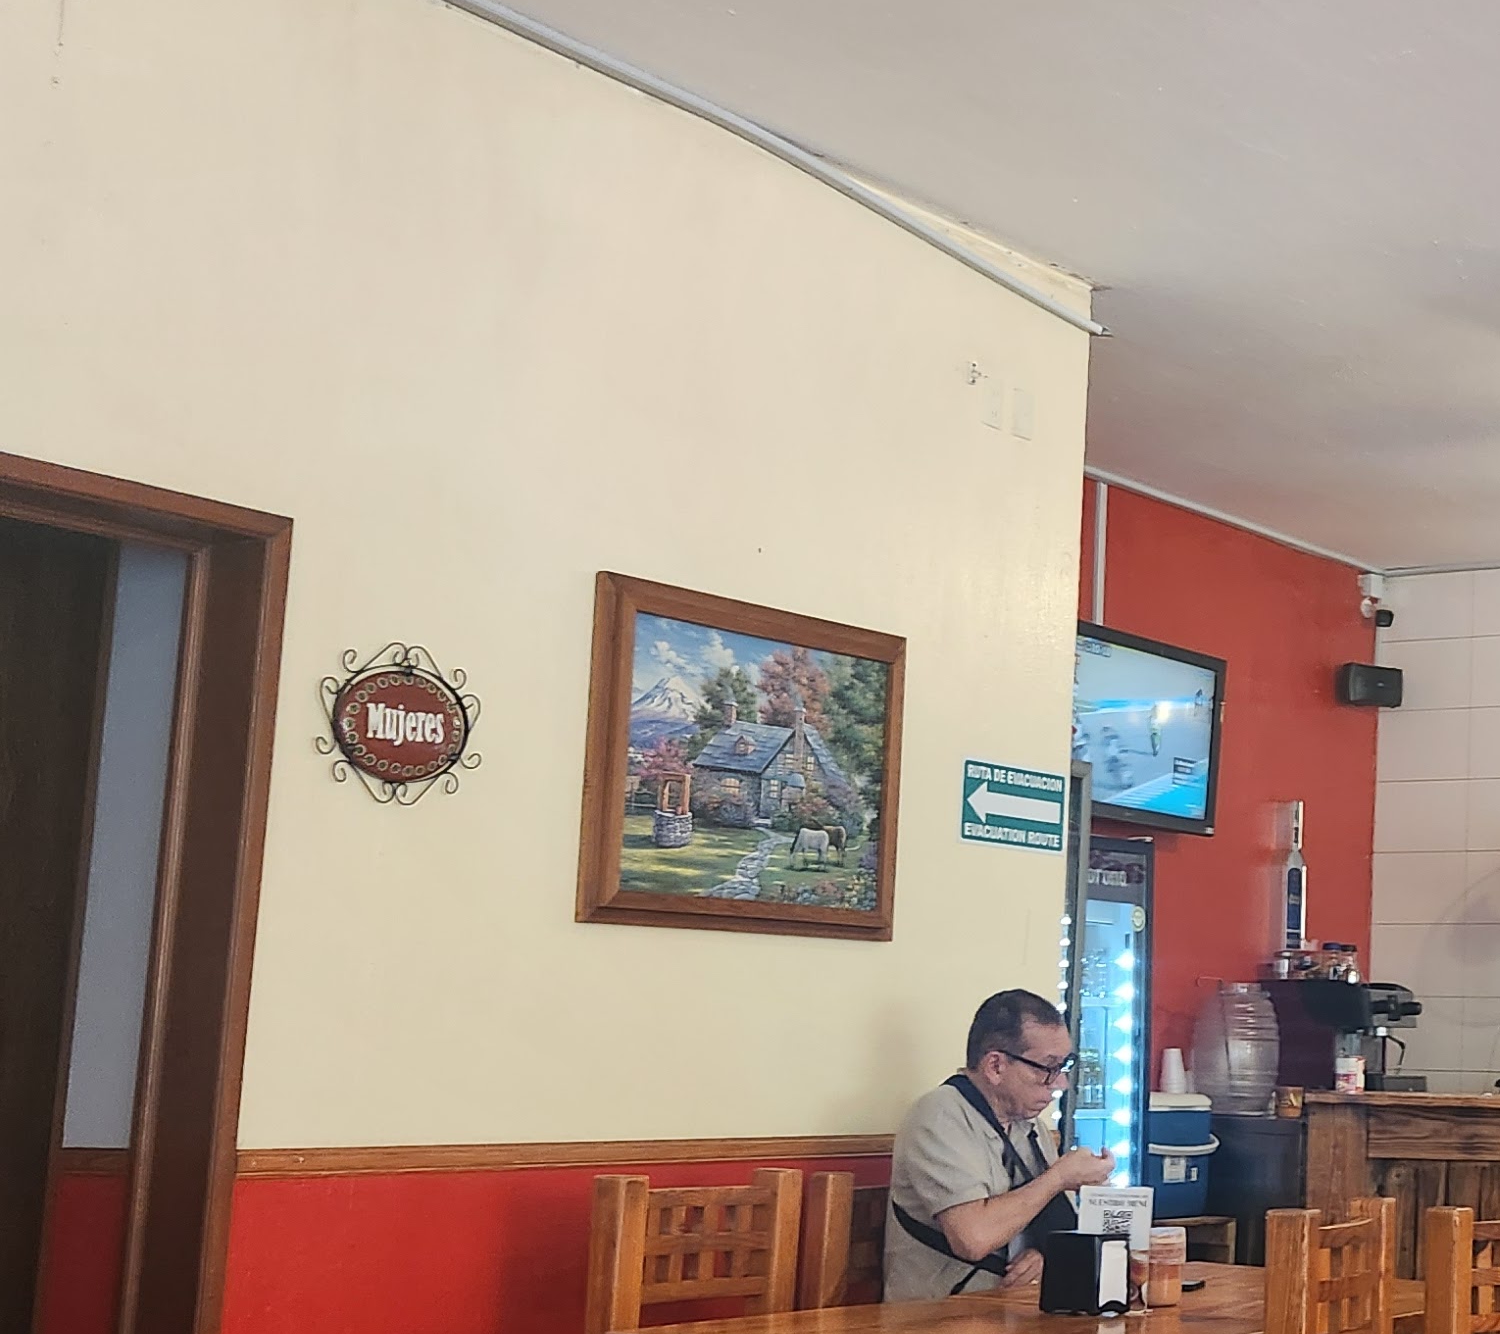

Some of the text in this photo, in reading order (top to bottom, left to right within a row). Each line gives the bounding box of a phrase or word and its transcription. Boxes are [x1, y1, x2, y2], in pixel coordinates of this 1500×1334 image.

[366, 702, 445, 746] Mujeres
[967, 763, 1063, 793] RUTA DE EVACUACION
[964, 822, 1061, 848] EVACUATION ROUTE
